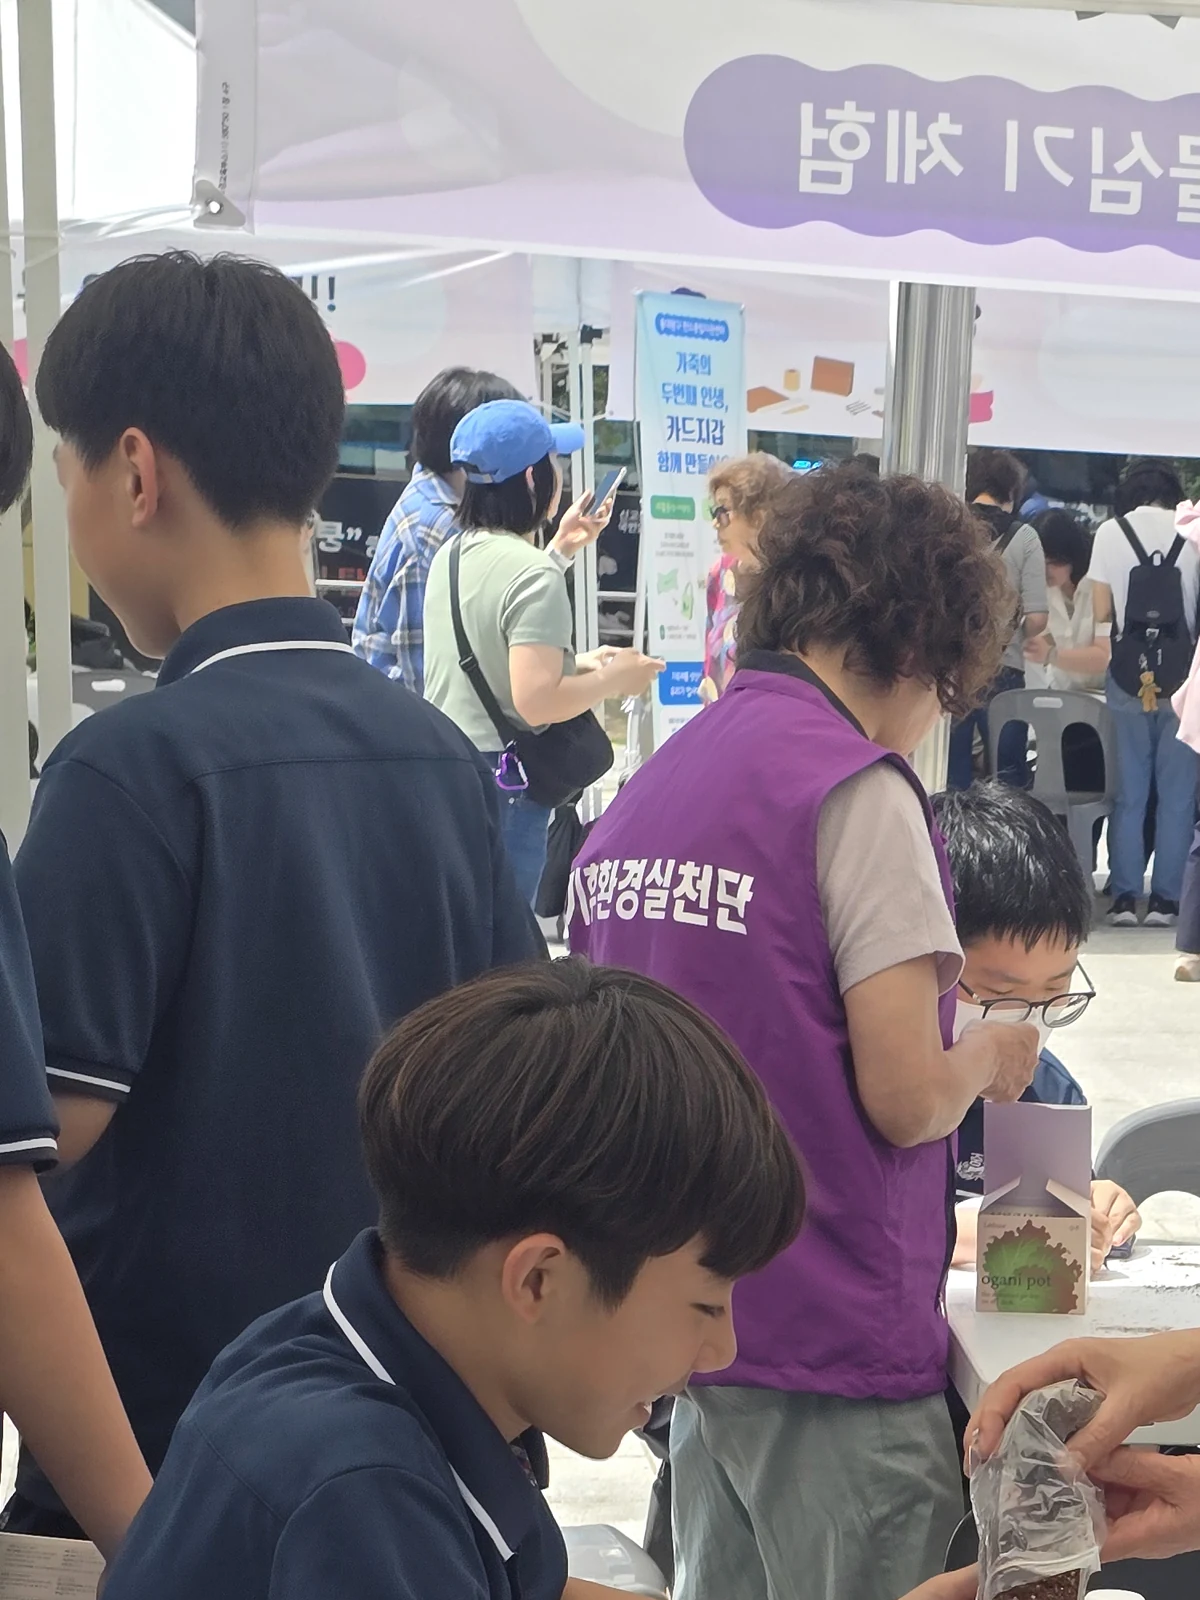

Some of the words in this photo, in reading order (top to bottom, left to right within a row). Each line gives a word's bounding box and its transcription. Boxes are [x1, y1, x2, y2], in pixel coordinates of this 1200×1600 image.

[676, 351, 712, 376] 가죽의
[666, 415, 726, 446] 카드지갑
[981, 1272, 1022, 1289] ogani
[1026, 1274, 1052, 1290] pot
